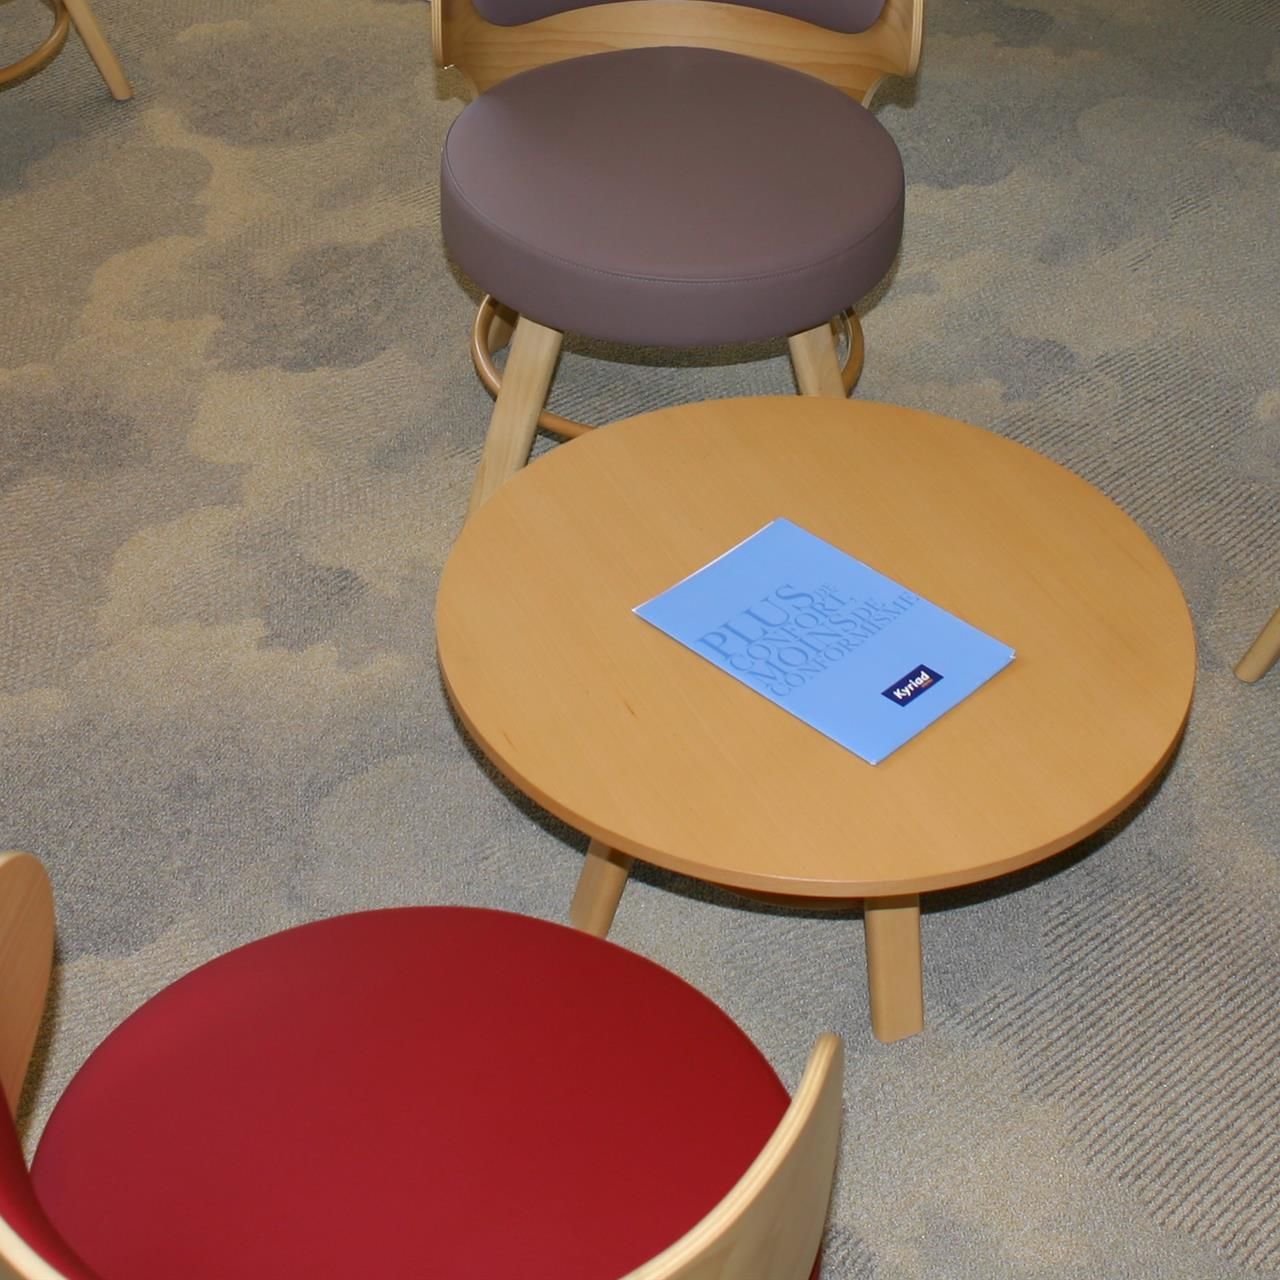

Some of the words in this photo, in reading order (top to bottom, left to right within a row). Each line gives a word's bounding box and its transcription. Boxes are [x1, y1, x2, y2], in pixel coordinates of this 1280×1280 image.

[697, 584, 815, 660] PLUS
[813, 583, 839, 601] DE
[730, 589, 857, 671] CONFORT,
[747, 612, 857, 687] MOINS
[850, 596, 886, 623] DE
[892, 670, 931, 700] Kyriad
